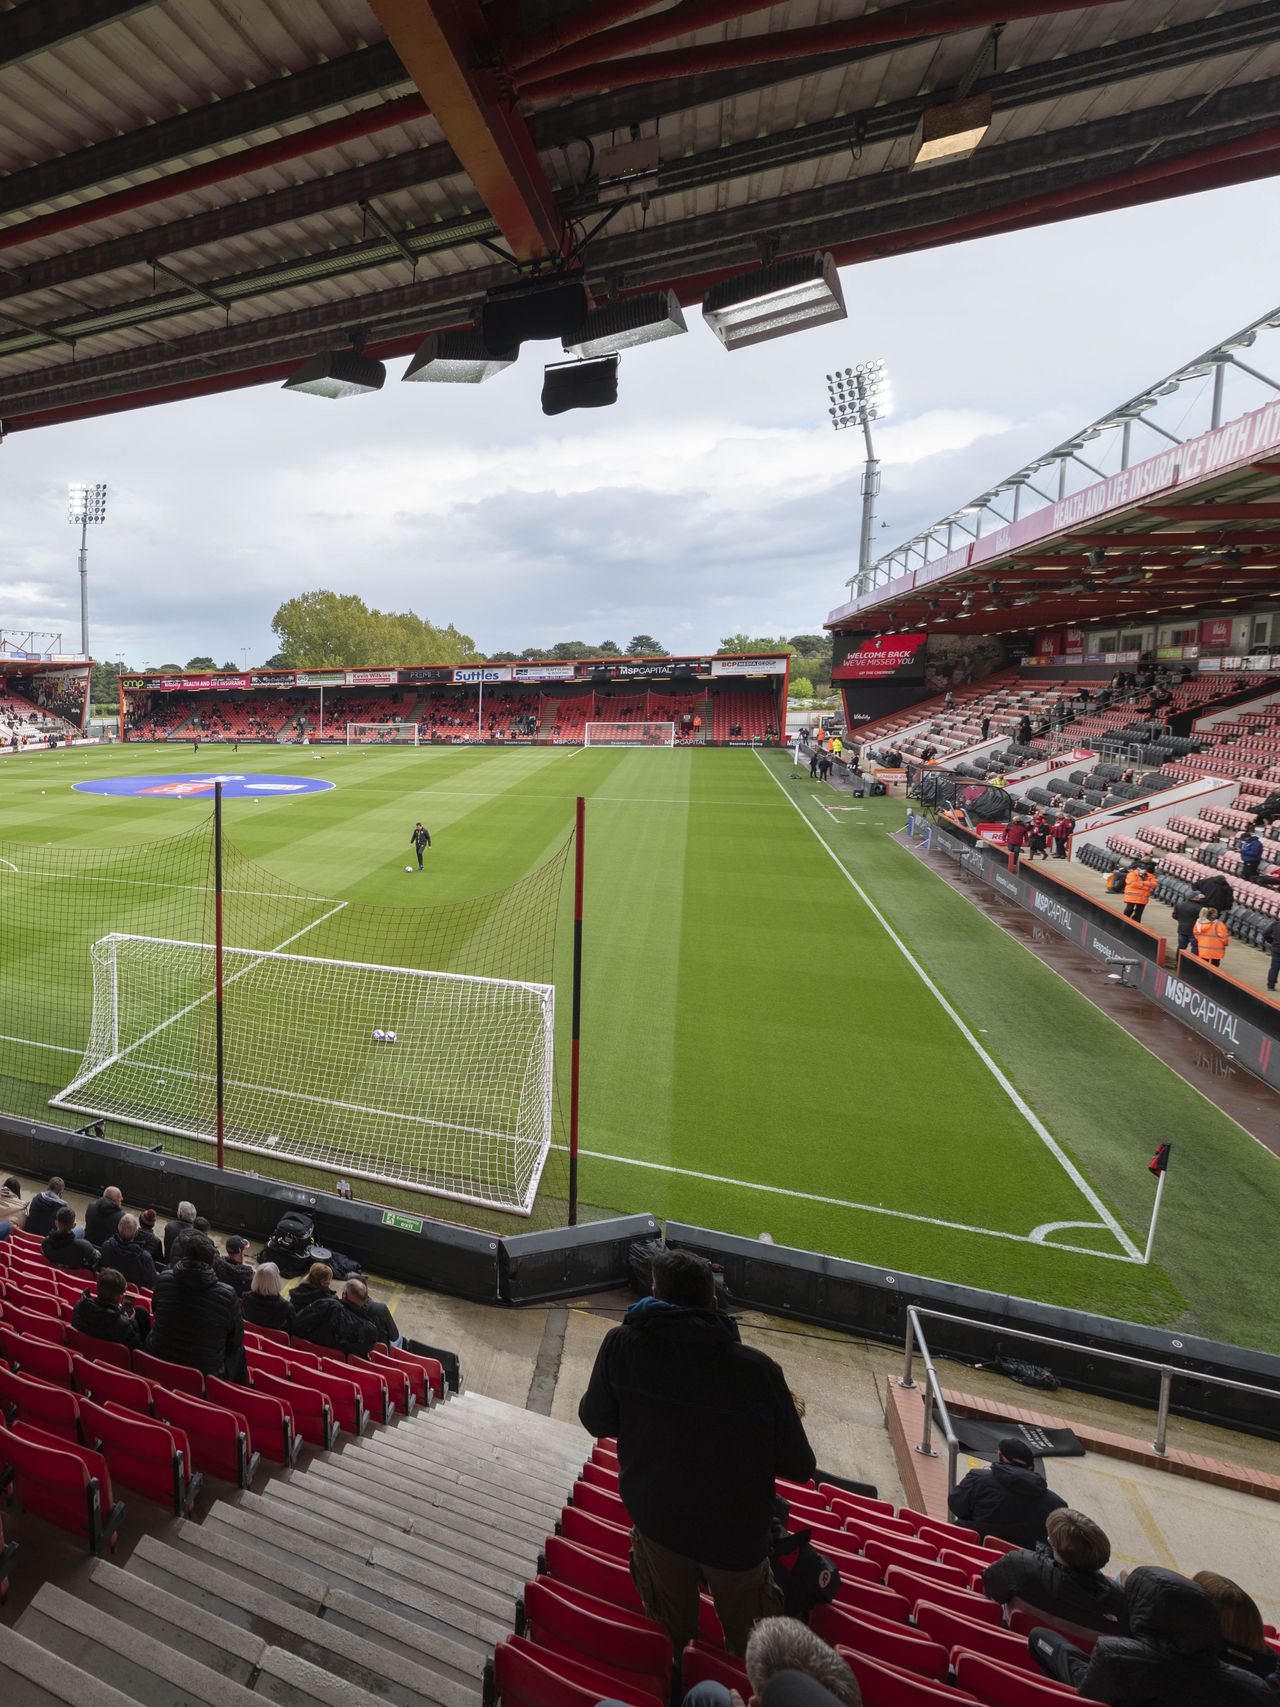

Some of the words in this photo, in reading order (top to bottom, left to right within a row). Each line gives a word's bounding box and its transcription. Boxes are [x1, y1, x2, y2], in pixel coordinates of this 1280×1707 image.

[1053, 494, 1084, 531] HEALTH
[1084, 486, 1106, 516] AND
[1107, 475, 1129, 506] LIFE
[1129, 438, 1206, 499] INSURANCE
[1206, 418, 1251, 468] WITH
[847, 652, 886, 660] WELCOME
[455, 670, 499, 680] Suttles
[620, 666, 672, 675] MSPCAPITAL
[123, 680, 144, 688] cmp
[1034, 891, 1072, 930] MSPCAPITAL
[1093, 938, 1111, 958] Bespoke
[1165, 976, 1240, 1045] MSPCAPITAL
[401, 1222, 414, 1230] exit
